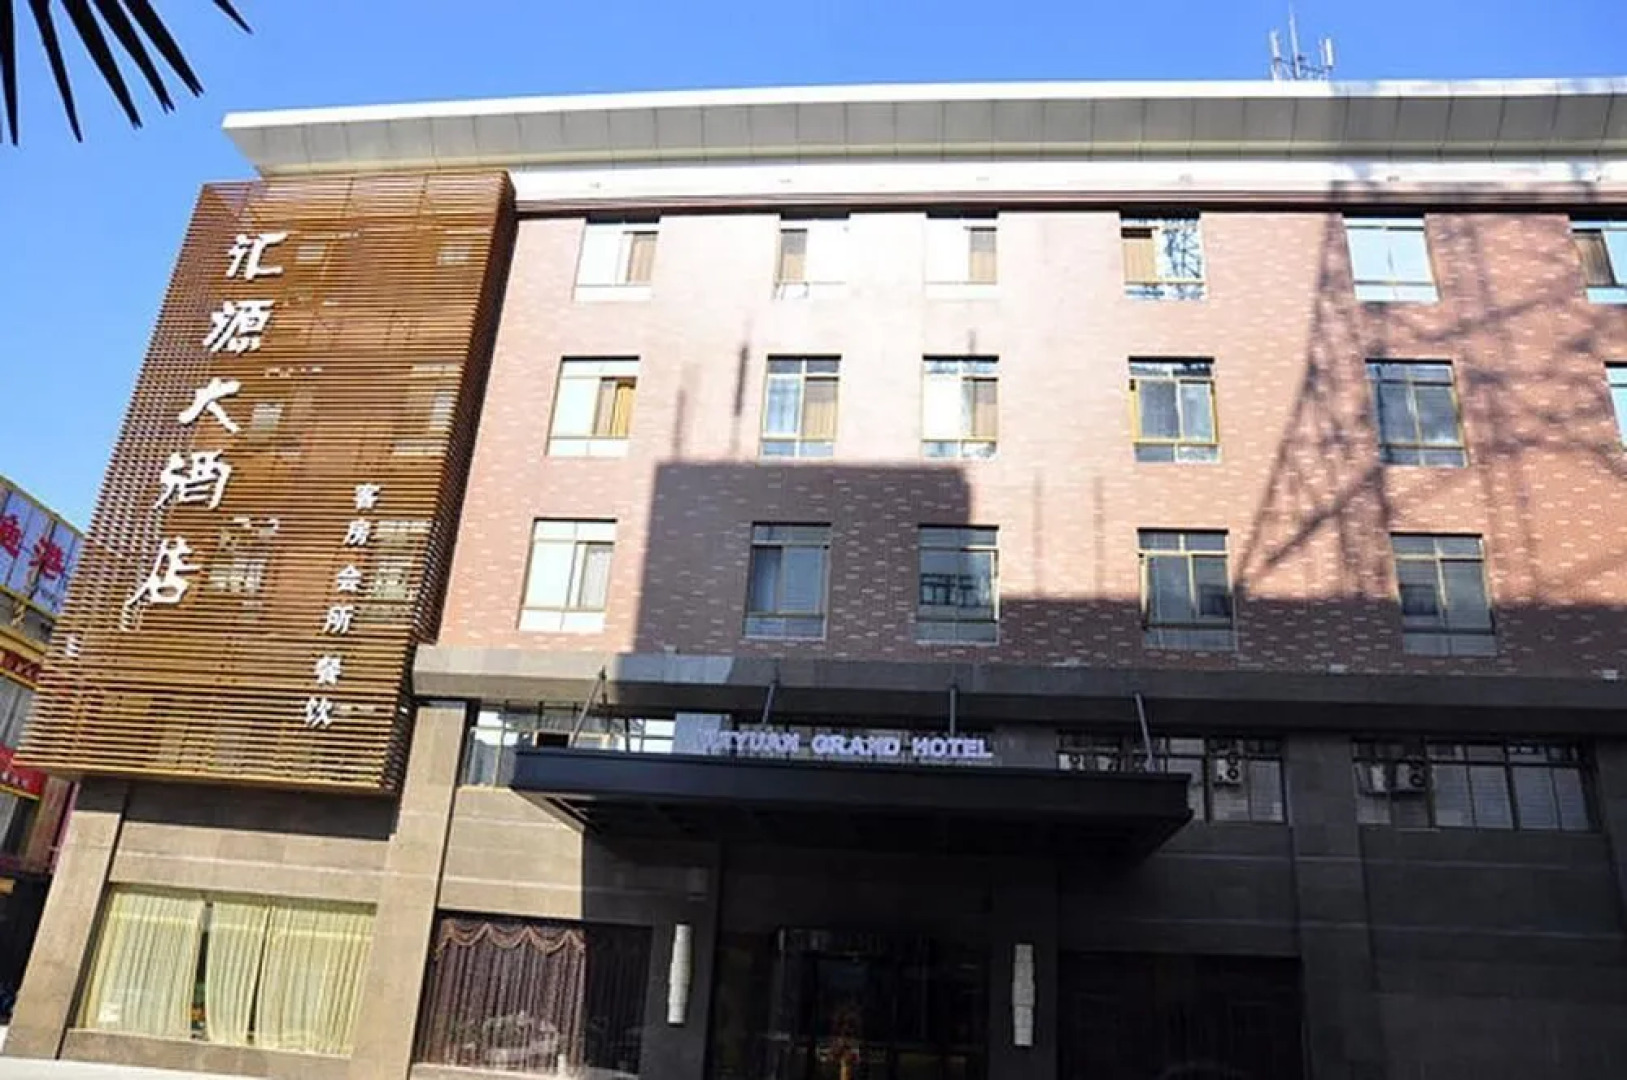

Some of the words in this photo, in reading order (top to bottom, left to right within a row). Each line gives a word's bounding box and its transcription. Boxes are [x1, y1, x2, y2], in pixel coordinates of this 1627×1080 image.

[123, 232, 288, 610] 汇源大酒店
[304, 482, 382, 728] 客房会所餐饮
[811, 733, 900, 757] GRAND
[912, 736, 993, 758] HOTEL
